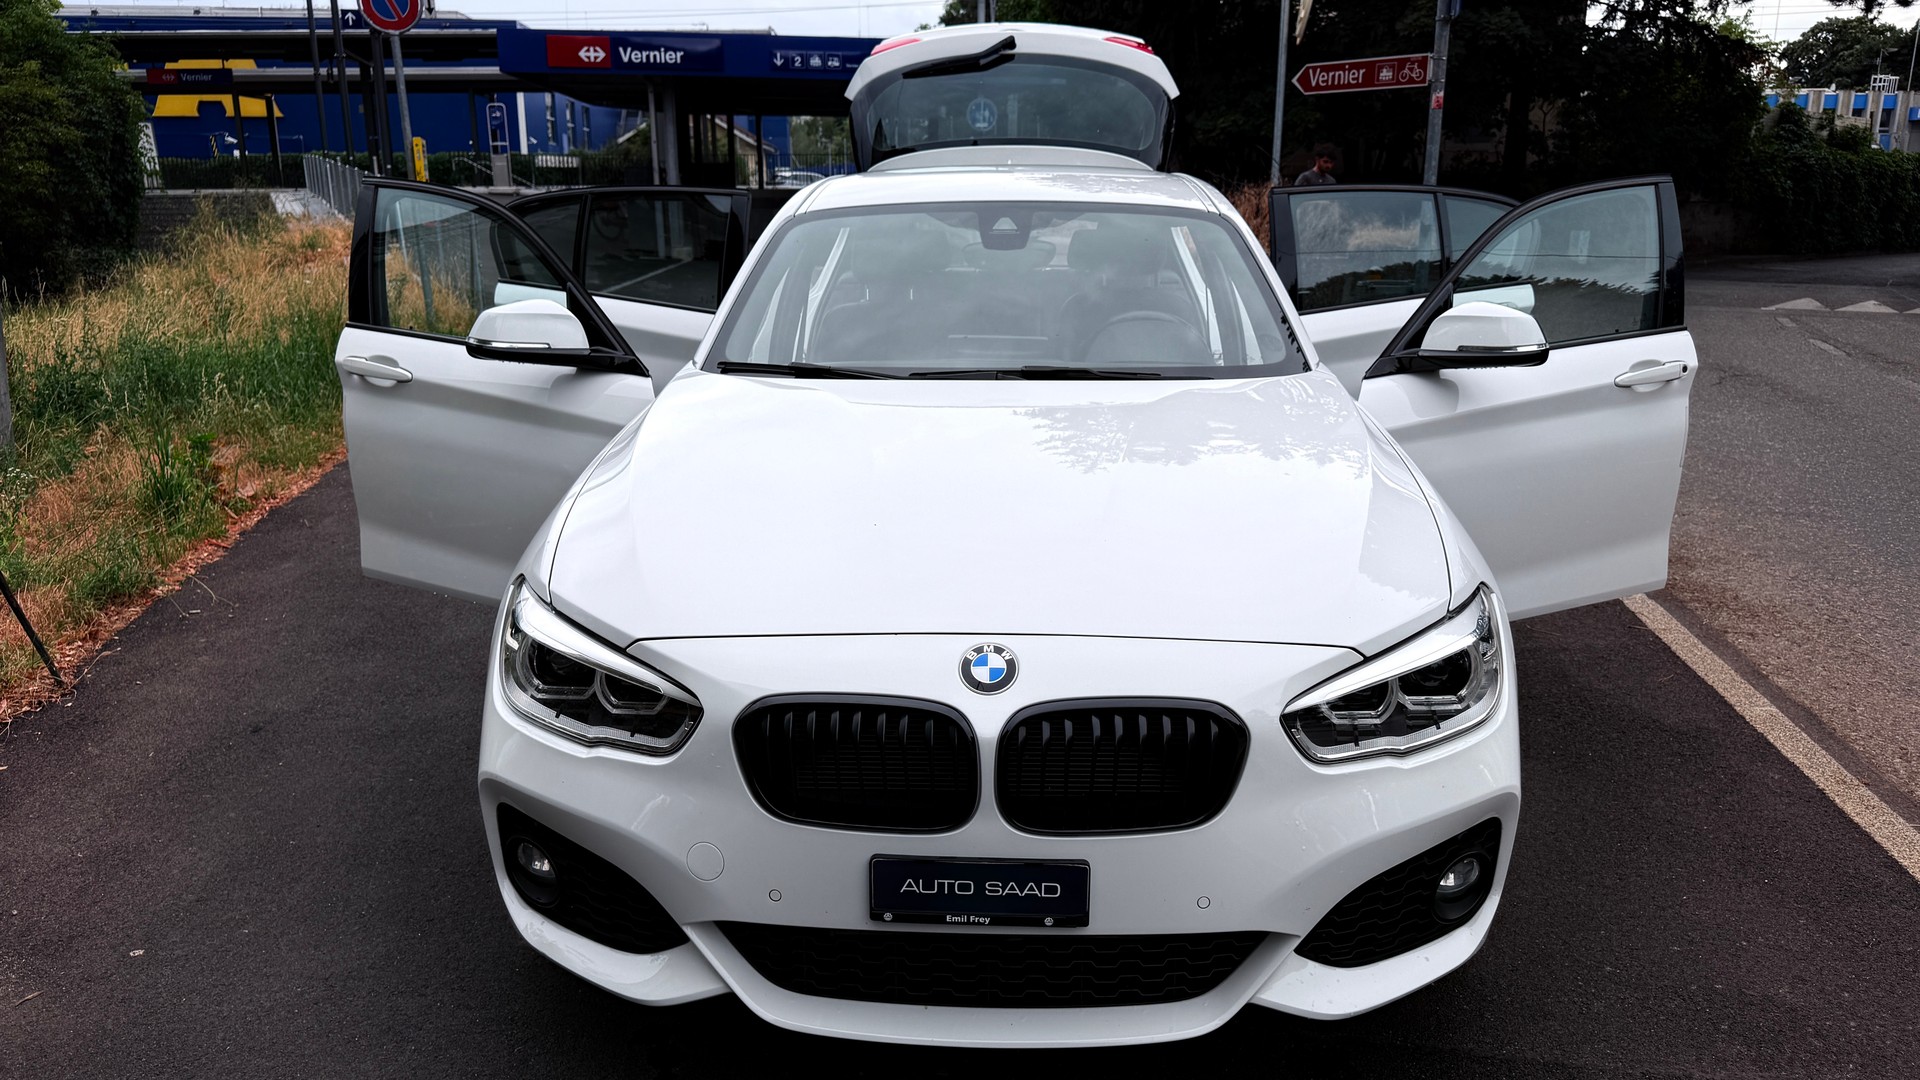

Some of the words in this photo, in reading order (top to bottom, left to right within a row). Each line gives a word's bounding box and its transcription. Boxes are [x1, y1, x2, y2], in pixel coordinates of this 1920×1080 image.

[618, 46, 684, 64] Vernier
[793, 55, 802, 67] 2
[180, 72, 213, 82] Vernier
[1309, 64, 1366, 87] Vernier
[966, 645, 1013, 660] BMW
[900, 878, 974, 895] AUTO
[985, 881, 1061, 898] SAAD
[946, 915, 967, 923] Emil
[970, 915, 990, 924] Frey
